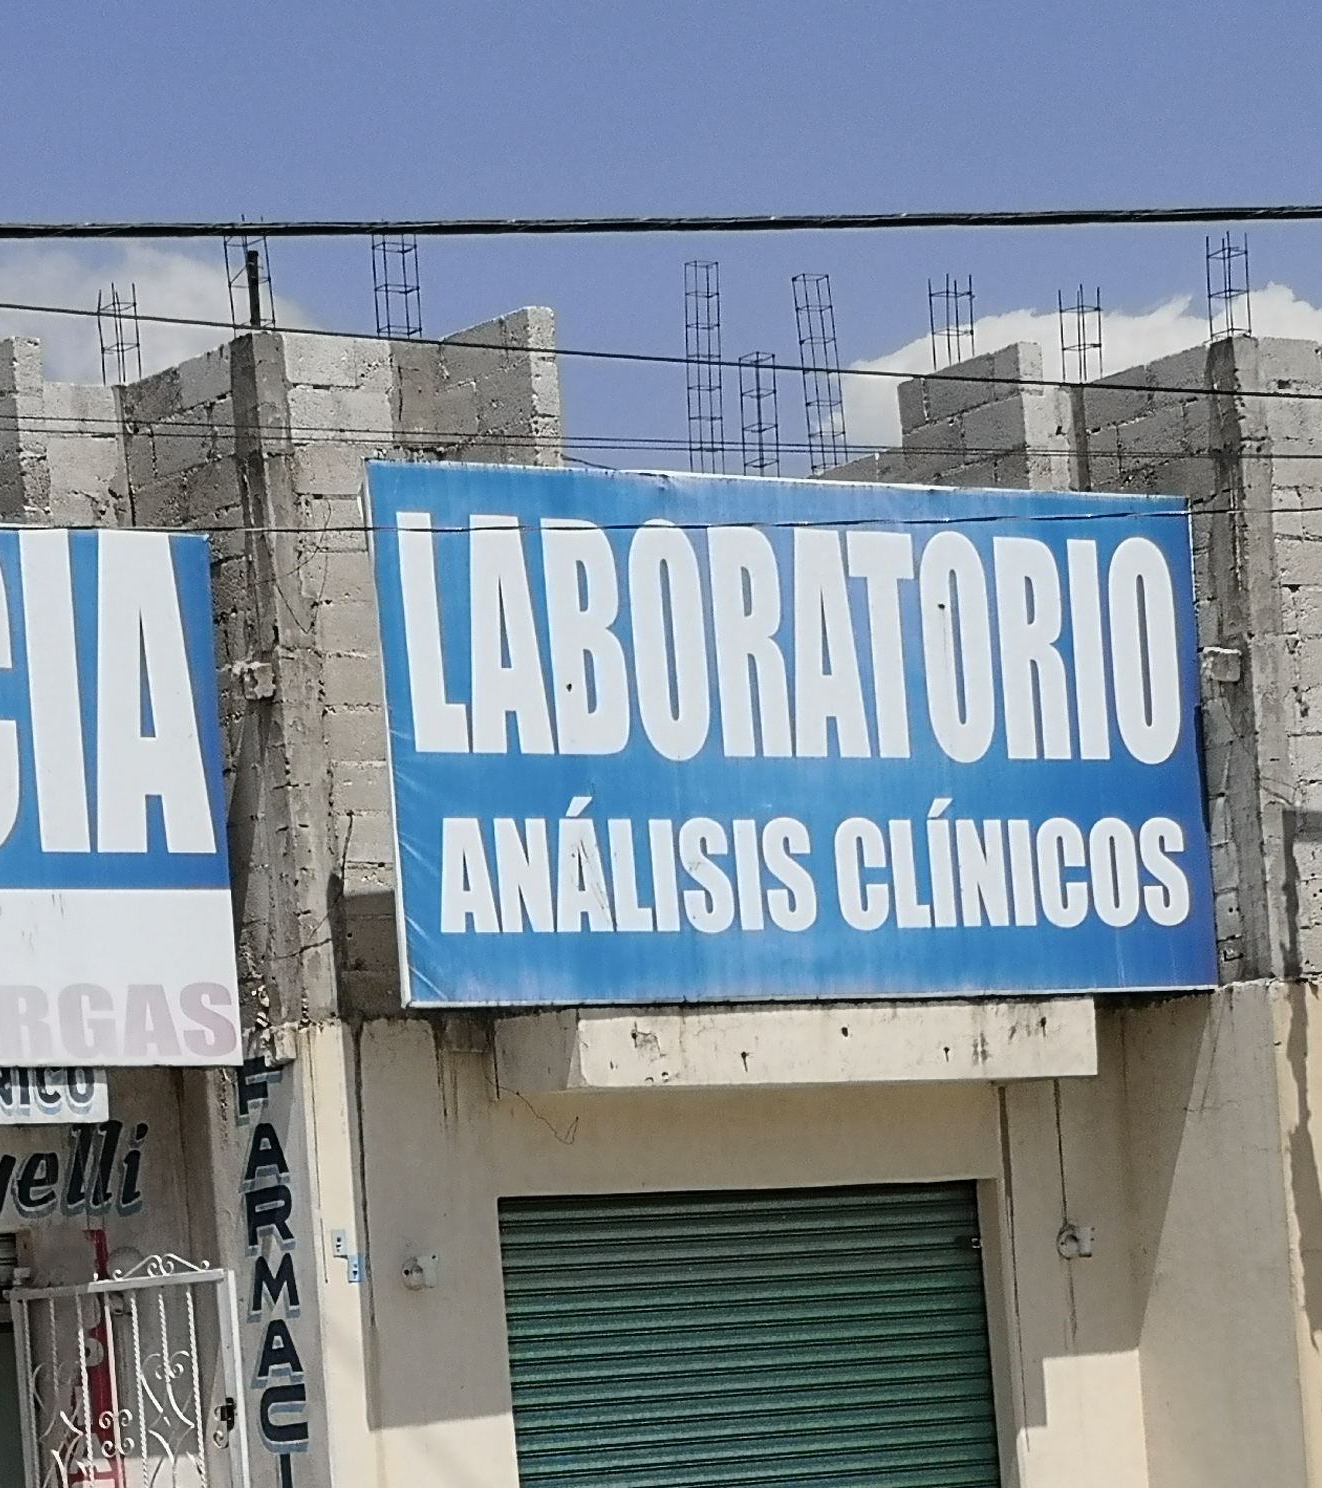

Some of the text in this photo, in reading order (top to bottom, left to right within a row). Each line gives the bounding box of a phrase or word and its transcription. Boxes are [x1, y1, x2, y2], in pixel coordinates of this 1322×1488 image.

[395, 511, 1181, 764] LABORATORIO
[439, 796, 1189, 934] ANÁLISIS CLÍNICOS
